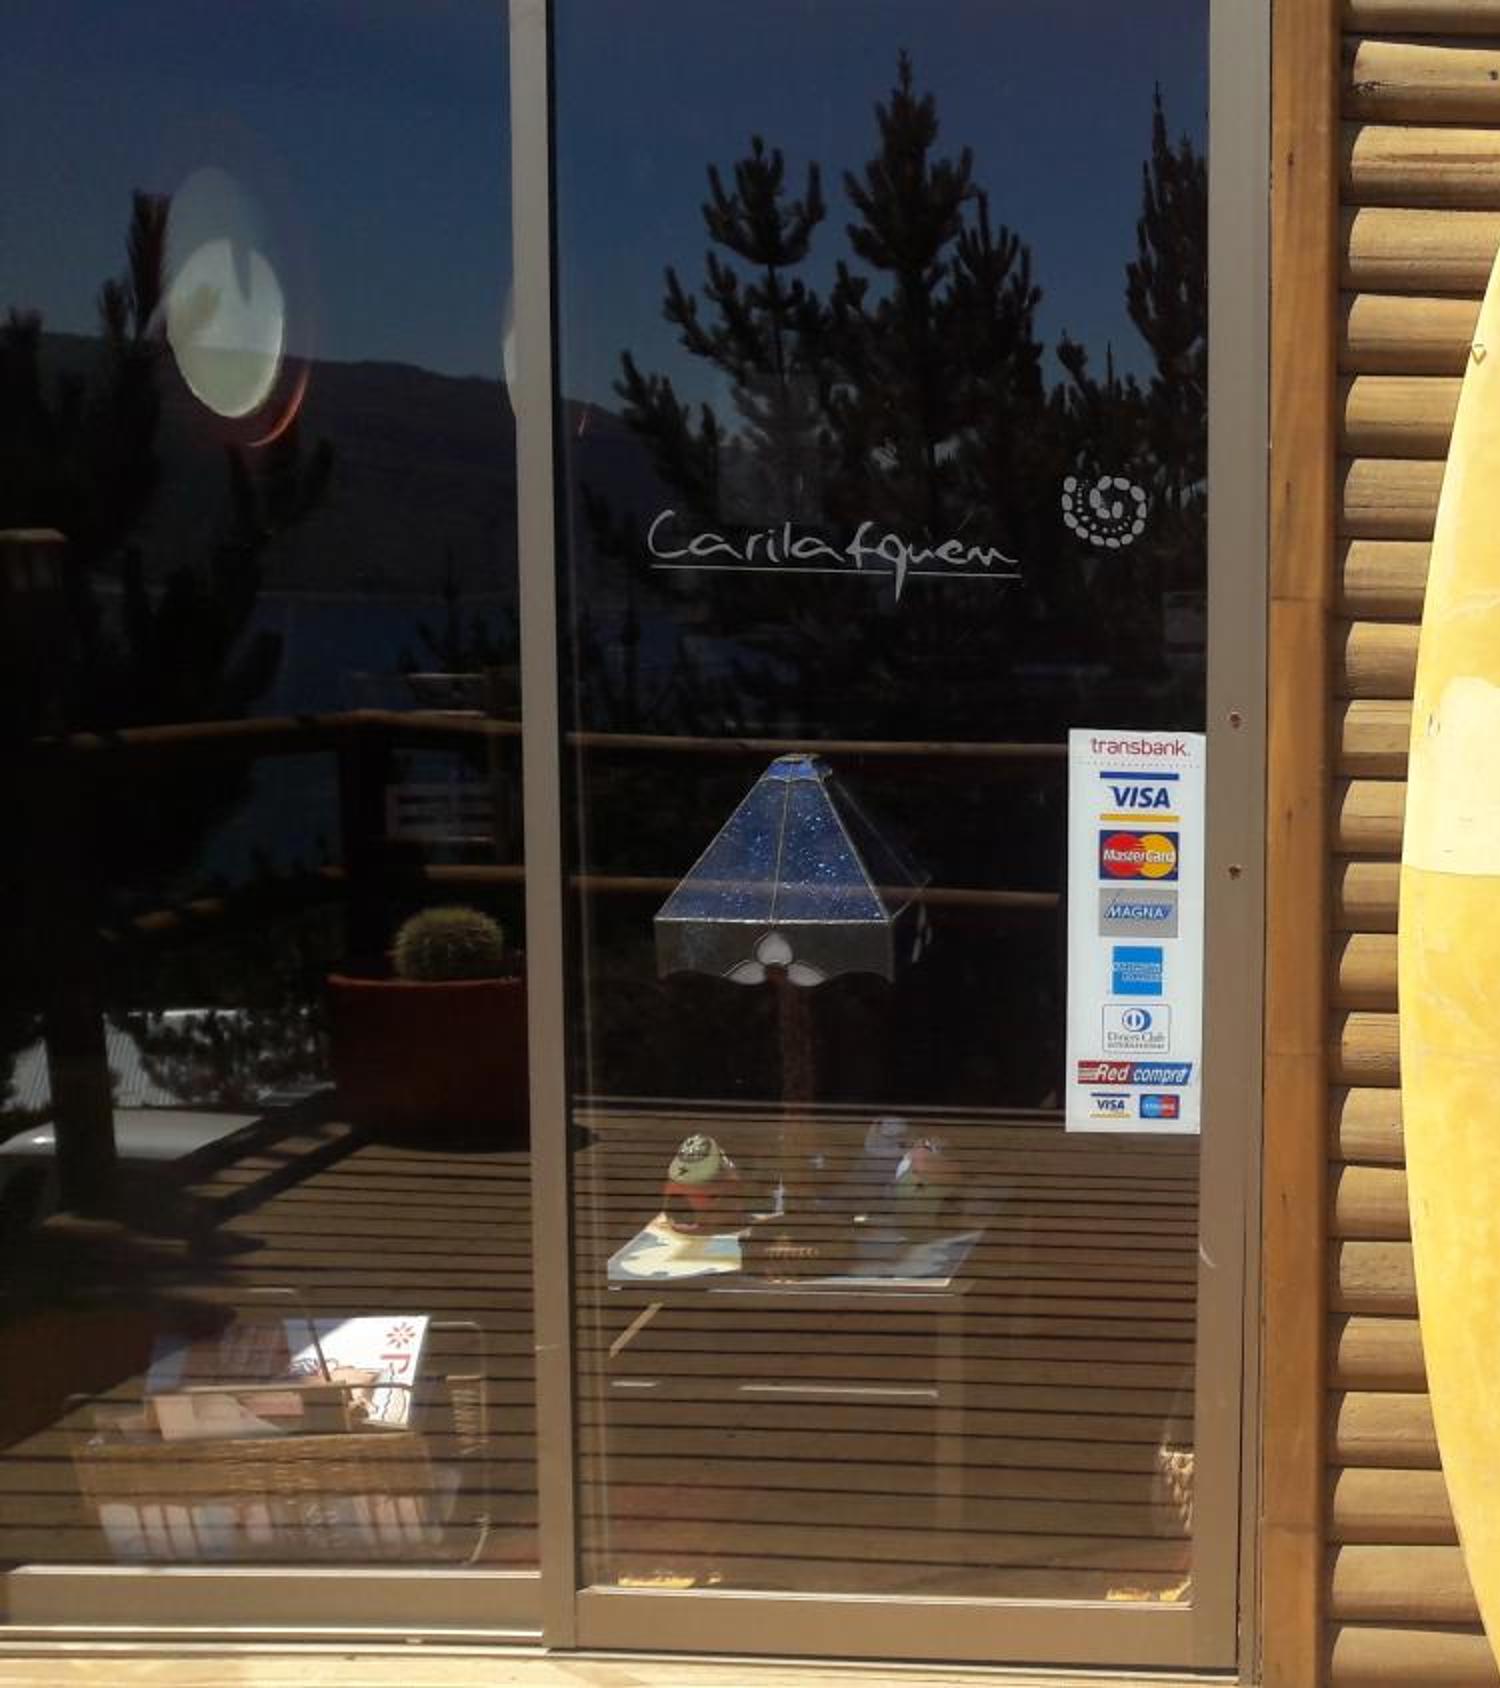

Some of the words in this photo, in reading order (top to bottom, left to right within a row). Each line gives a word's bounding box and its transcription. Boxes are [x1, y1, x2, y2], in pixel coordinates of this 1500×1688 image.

[1109, 786, 1171, 809] VISA
[1103, 849, 1176, 864] MasterCard
[1105, 903, 1168, 920] MAGNA
[1097, 1099, 1125, 1111] VISA
